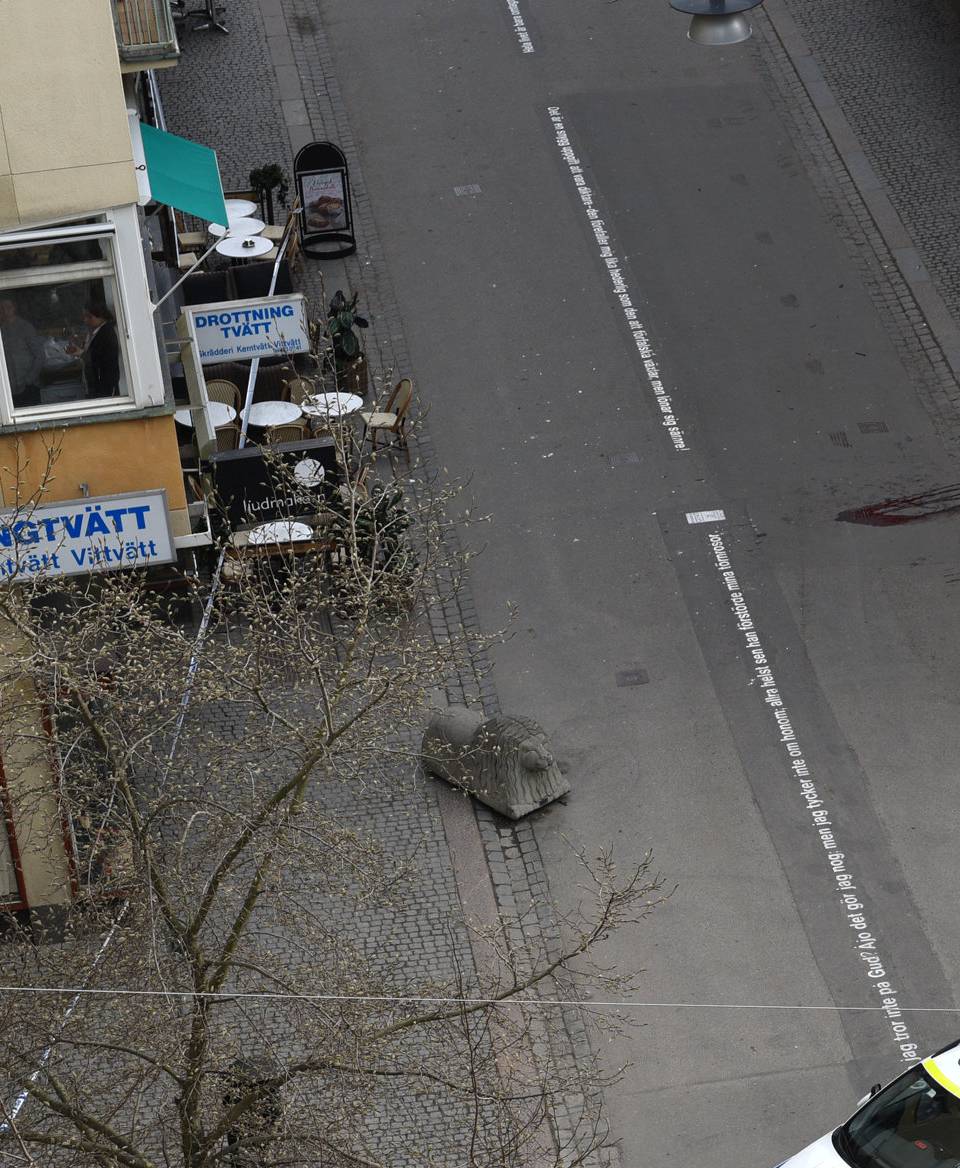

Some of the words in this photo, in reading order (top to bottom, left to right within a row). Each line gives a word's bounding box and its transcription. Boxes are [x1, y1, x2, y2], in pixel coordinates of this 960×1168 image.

[195, 305, 295, 328] DROTTNING
[220, 321, 272, 339] TVÄTT
[720, 571, 741, 592] mina
[731, 592, 755, 632] förstörde
[745, 631, 762, 649] han
[752, 648, 768, 665] sen
[755, 666, 777, 688] helst
[787, 742, 804, 757] om
[792, 759, 810, 778] inte
[800, 779, 824, 810] tycker
[811, 810, 832, 827] jag
[817, 828, 837, 850] men
[836, 874, 856, 891] jag
[839, 894, 864, 911] gör
[848, 913, 868, 930] det
[872, 981, 898, 996] på
[880, 997, 902, 1019] inte
[891, 1021, 910, 1042] tror
